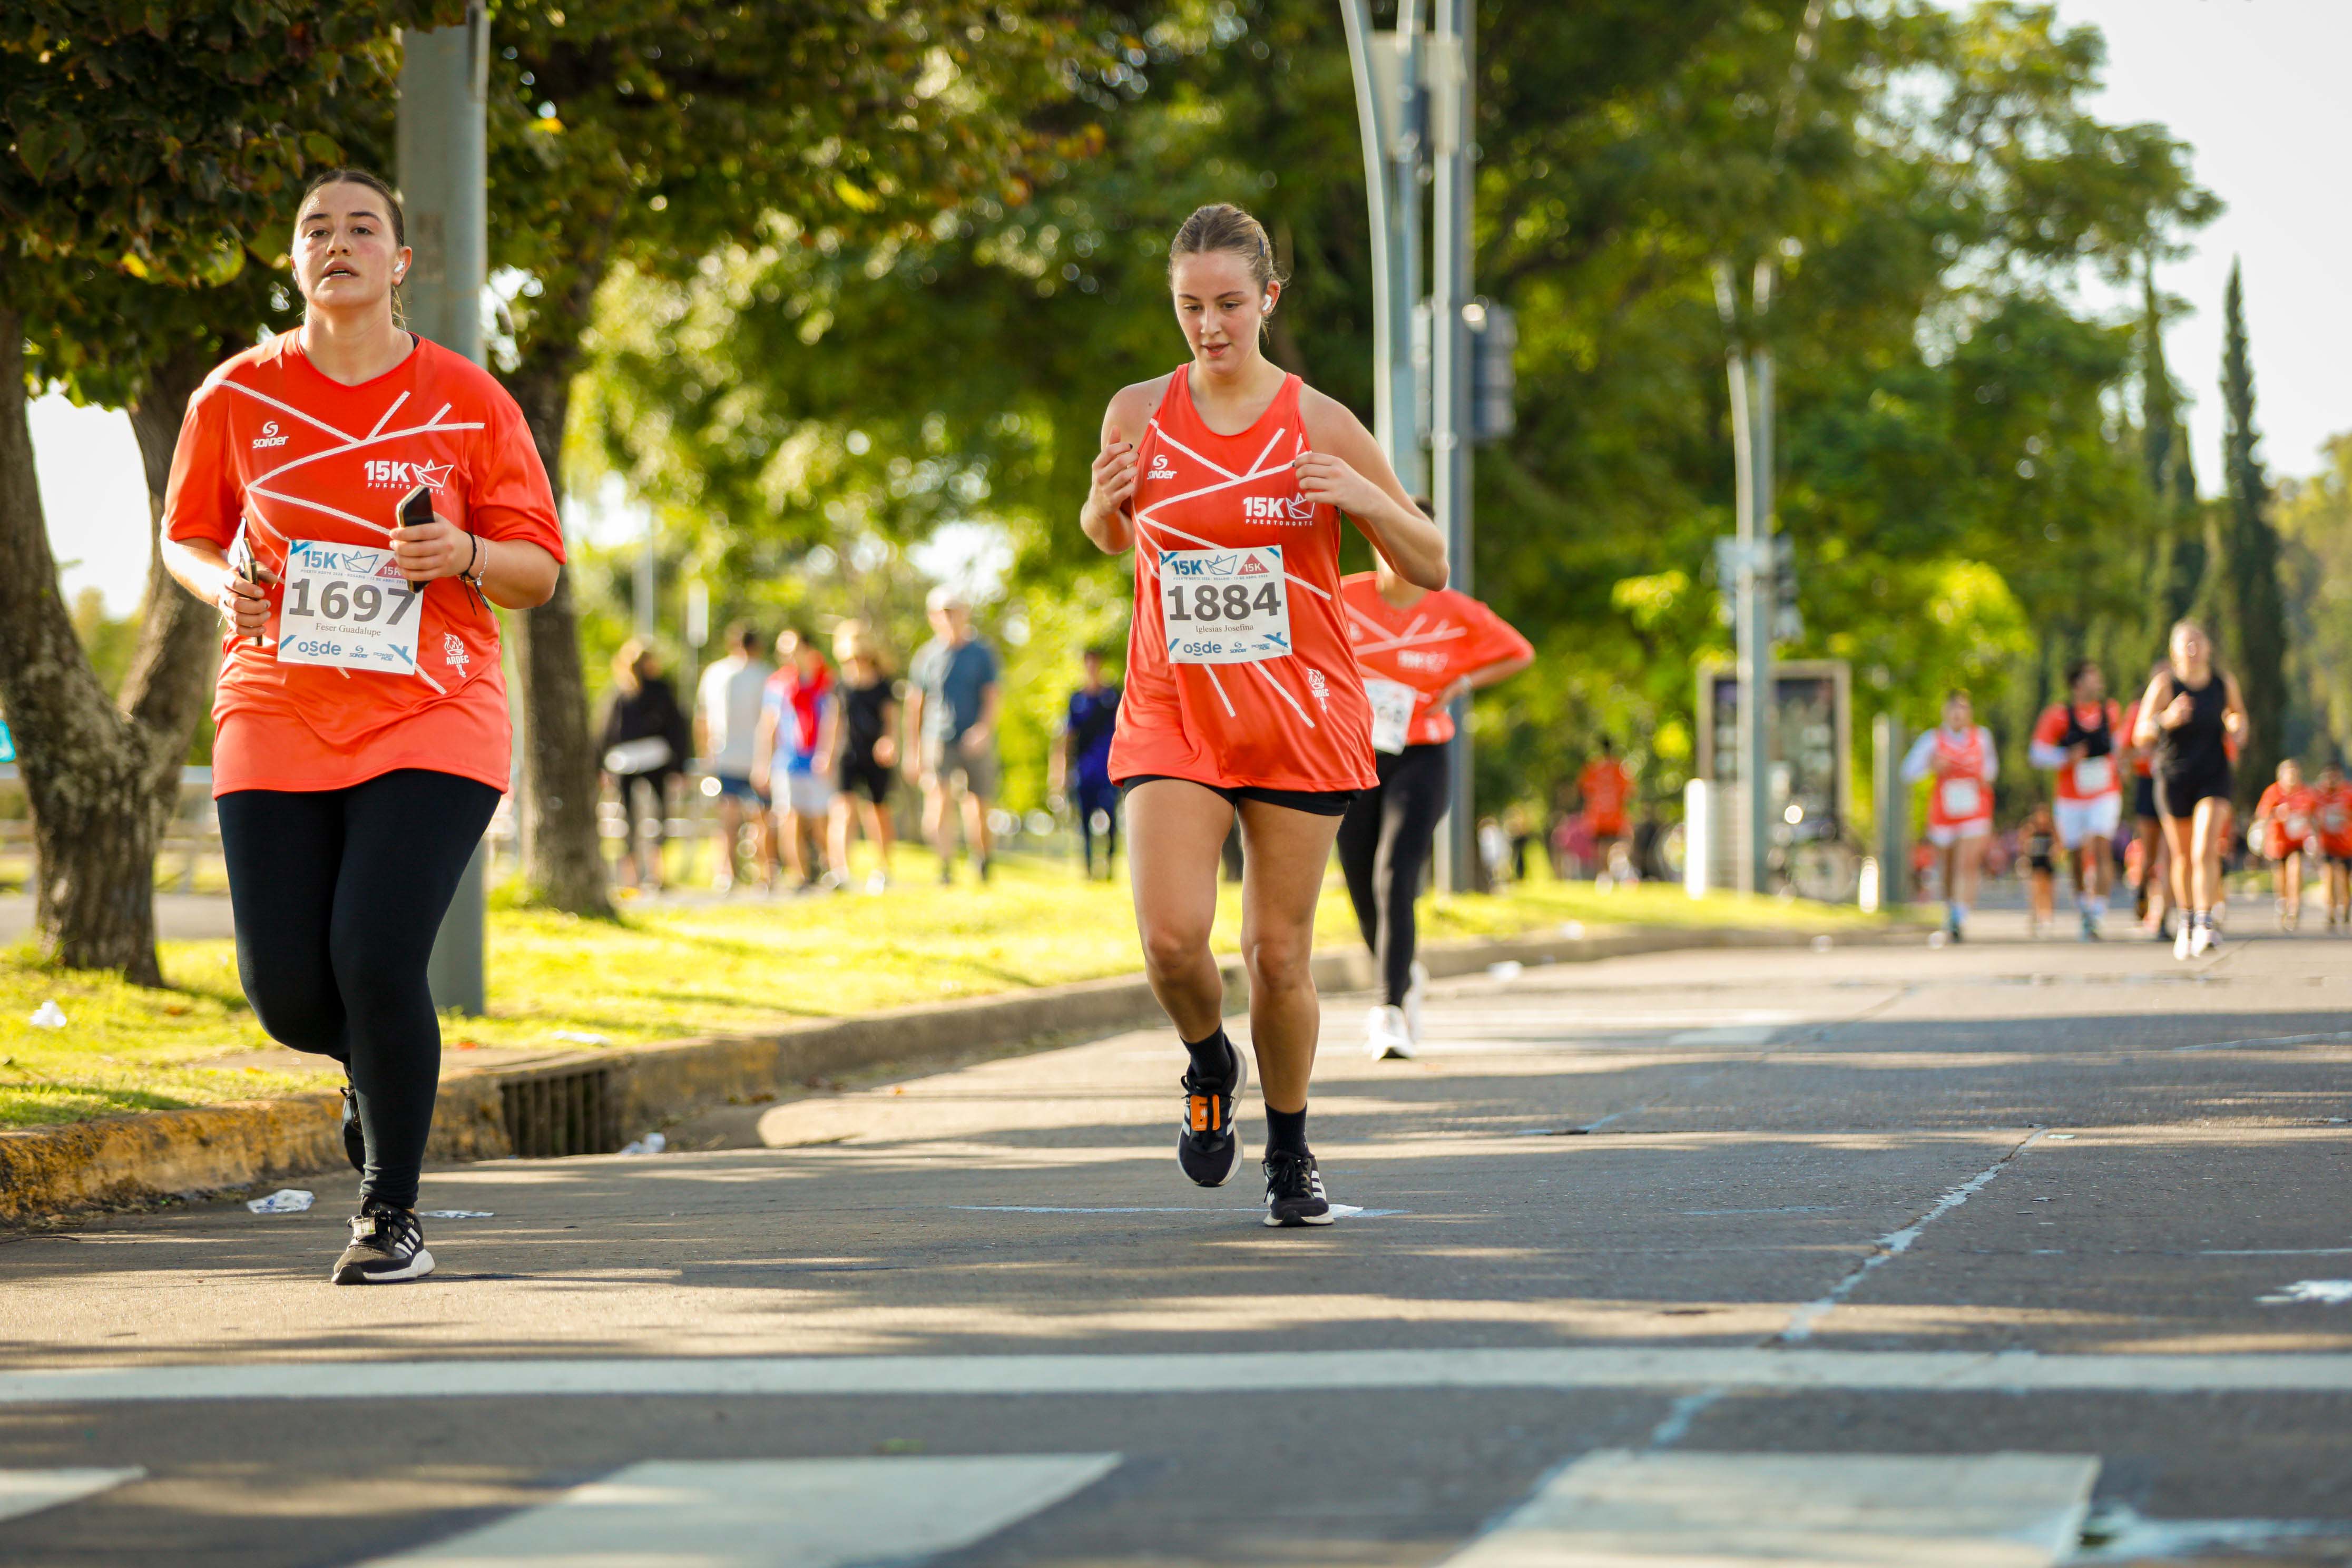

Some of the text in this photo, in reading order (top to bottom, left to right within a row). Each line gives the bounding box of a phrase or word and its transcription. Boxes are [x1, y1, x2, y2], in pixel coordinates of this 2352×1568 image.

[364, 460, 410, 482] 15K
[1243, 497, 1285, 518] 15K
[302, 550, 339, 570] 15K
[1171, 560, 1204, 575] 15K
[1244, 563, 1262, 572] 15K
[289, 578, 416, 625] 1697
[1168, 582, 1282, 622] 1884
[316, 623, 381, 638] Feser Guadalupe
[1196, 624, 1254, 634] Iglesias Josefina
[298, 641, 342, 656] osde
[1183, 640, 1222, 656] osde
[446, 654, 470, 665] ARDEC
